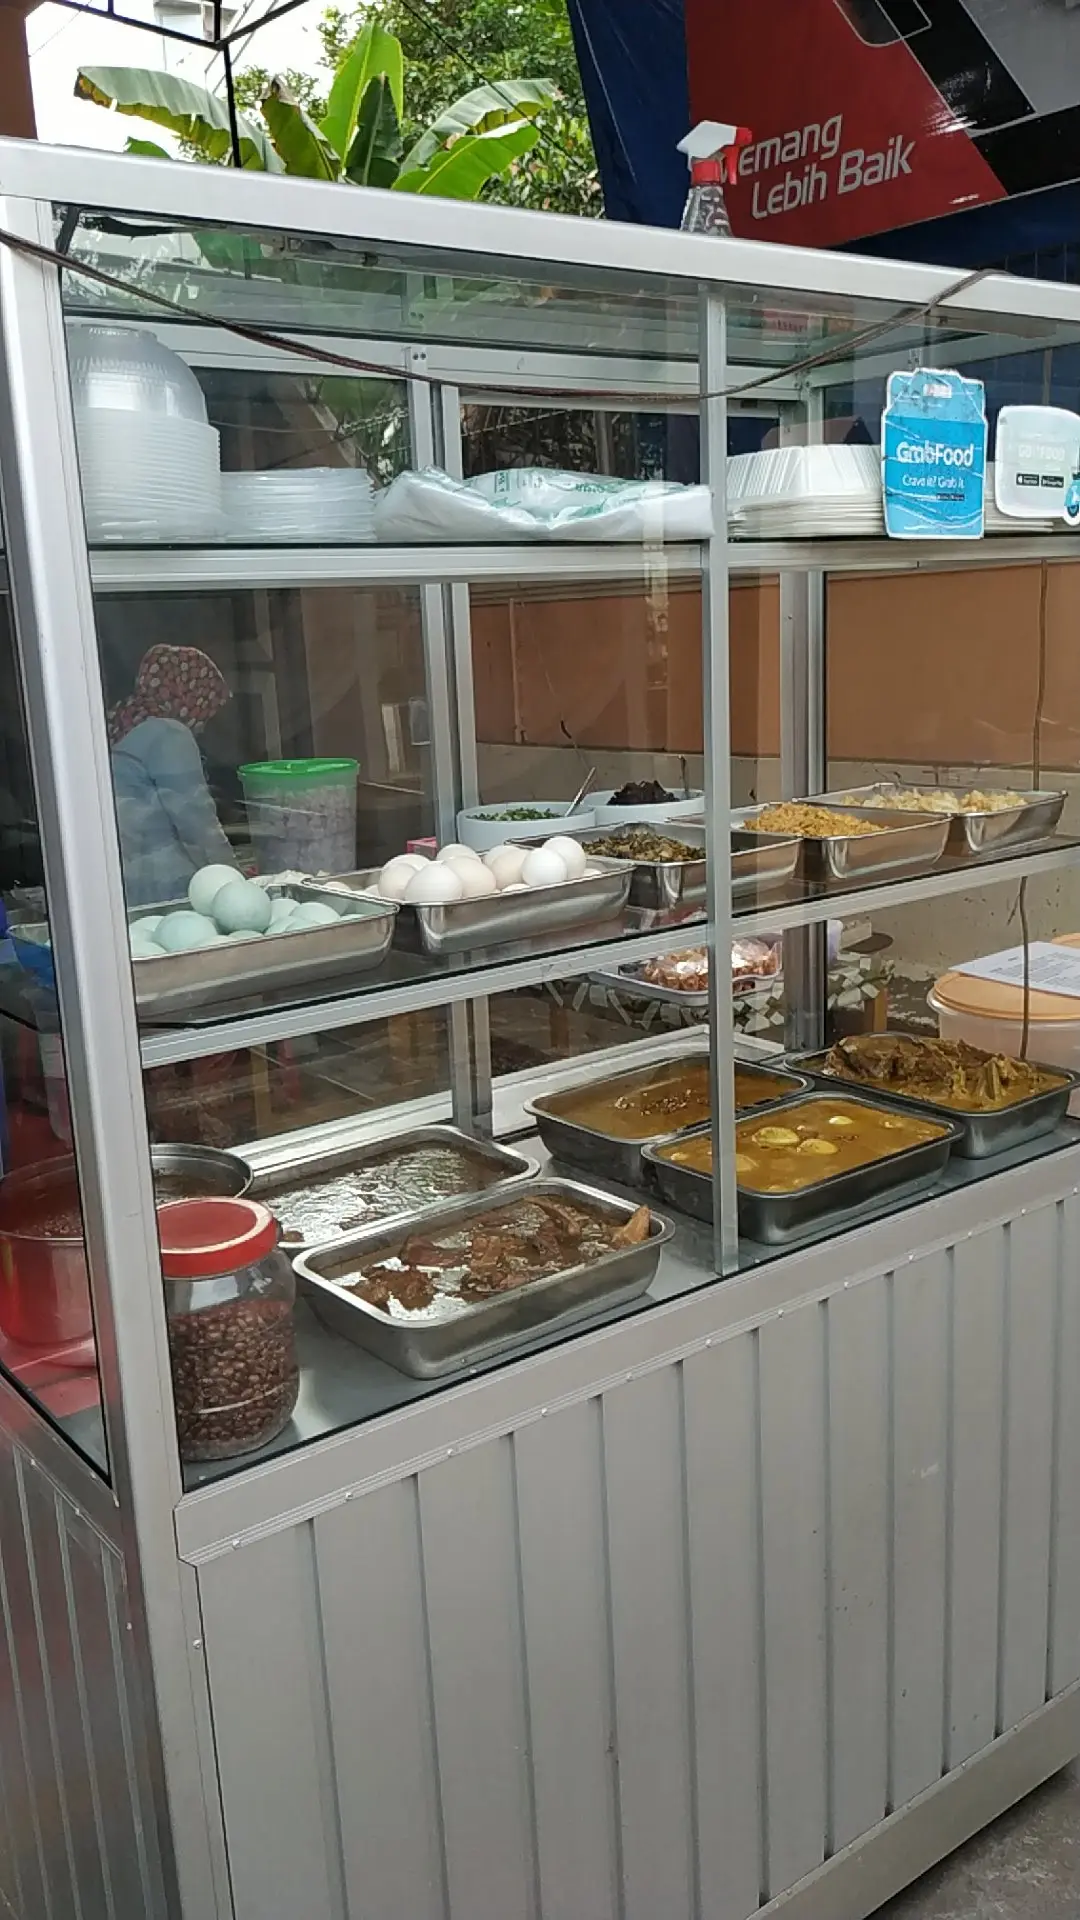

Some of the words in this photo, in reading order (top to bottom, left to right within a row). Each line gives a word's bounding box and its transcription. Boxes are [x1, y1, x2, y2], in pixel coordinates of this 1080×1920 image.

[750, 163, 828, 220] Lebih
[836, 134, 916, 195] Baik
[896, 440, 975, 468] GrabFood
